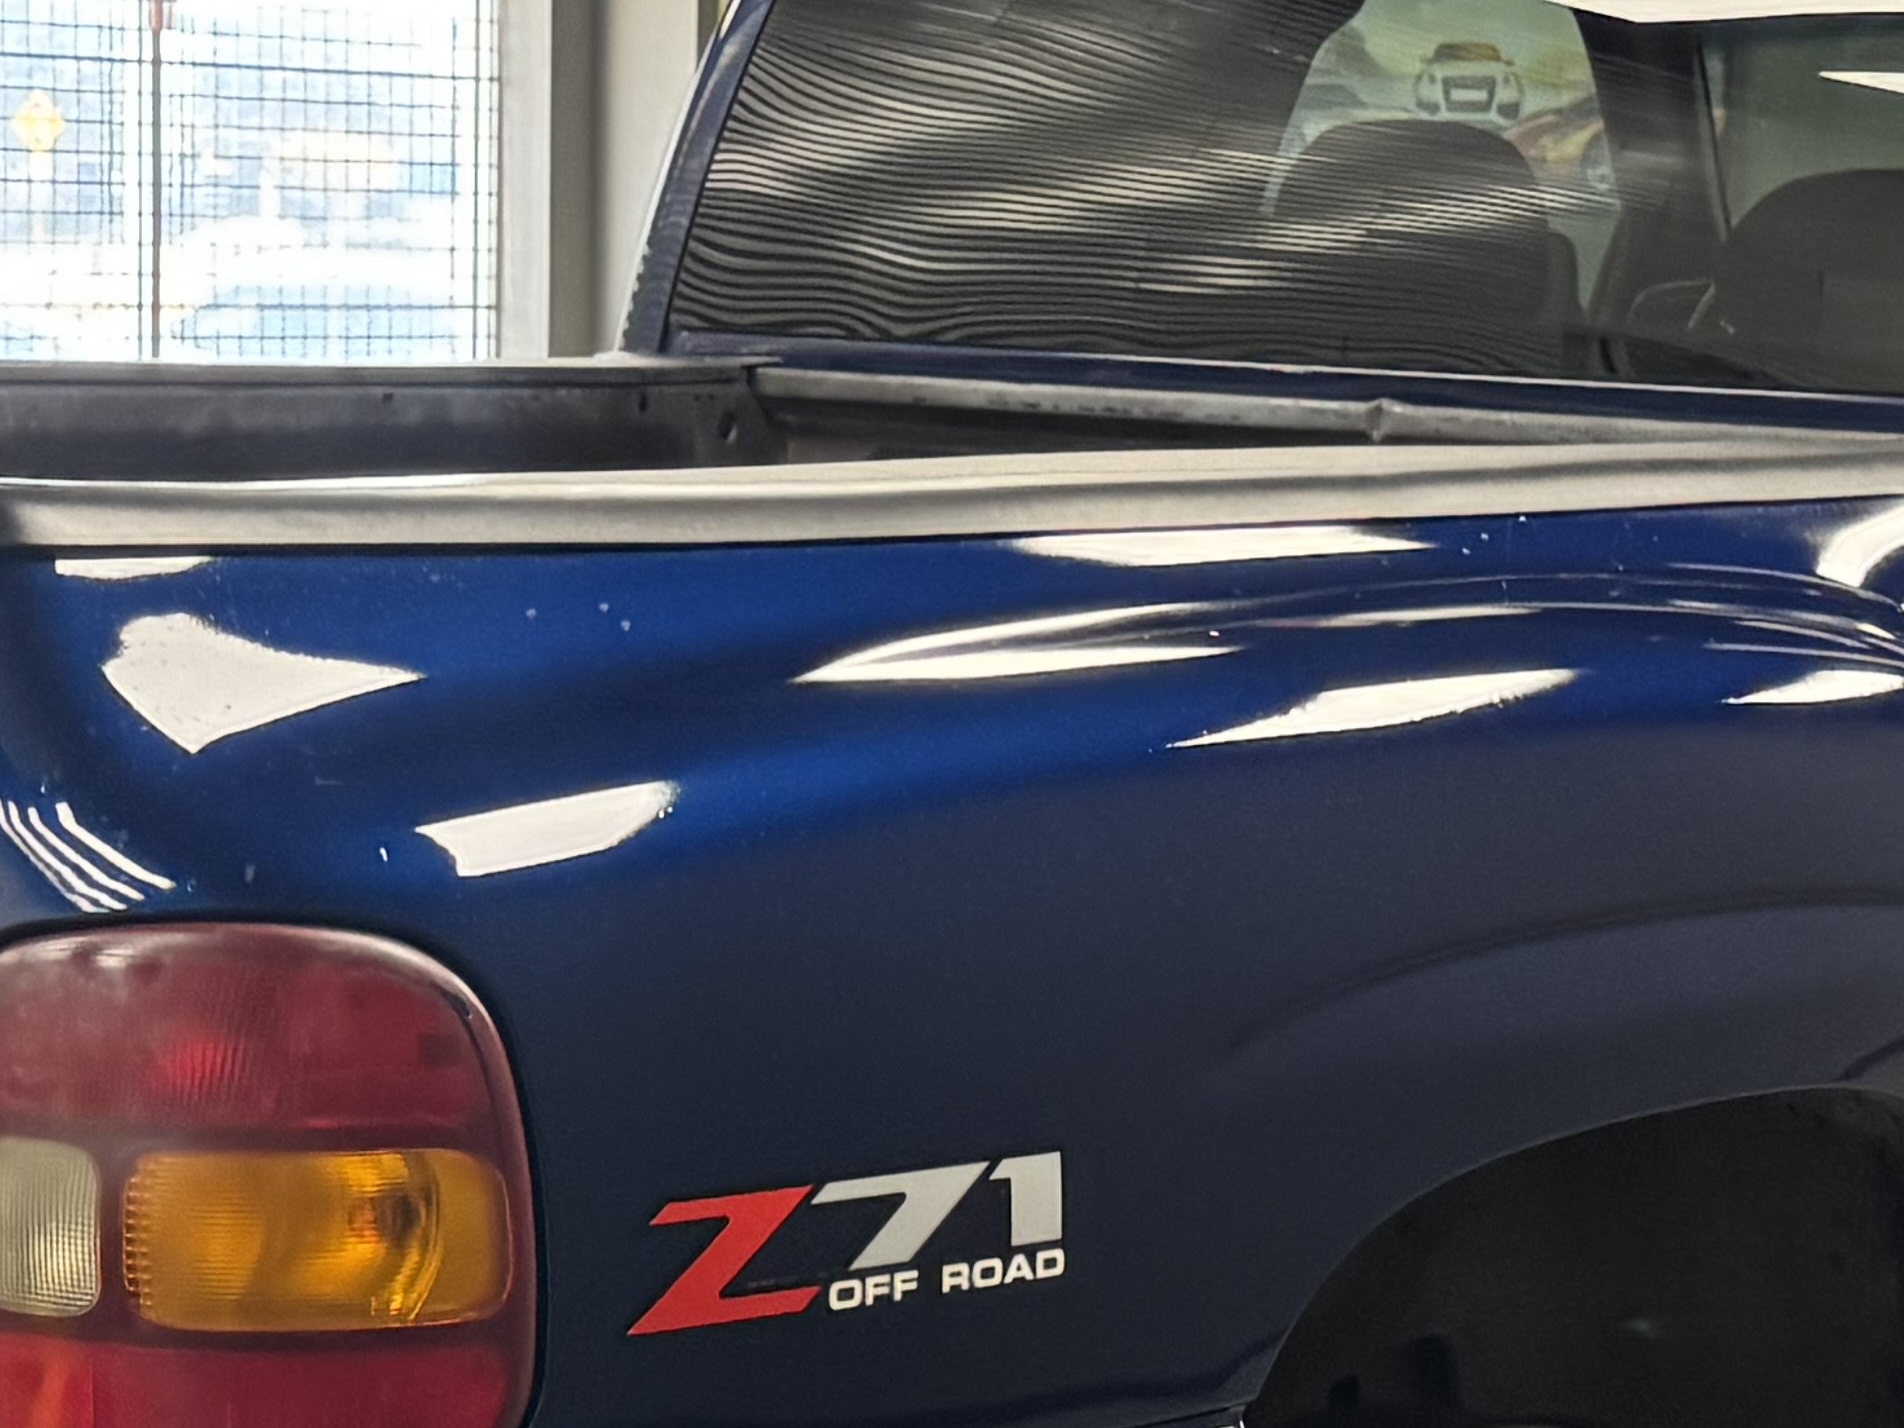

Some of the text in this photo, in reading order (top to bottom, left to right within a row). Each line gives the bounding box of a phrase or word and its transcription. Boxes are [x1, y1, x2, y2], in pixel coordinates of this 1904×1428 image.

[626, 1150, 1064, 1337] Z71
[827, 1247, 1066, 1311] OFF ROAD
